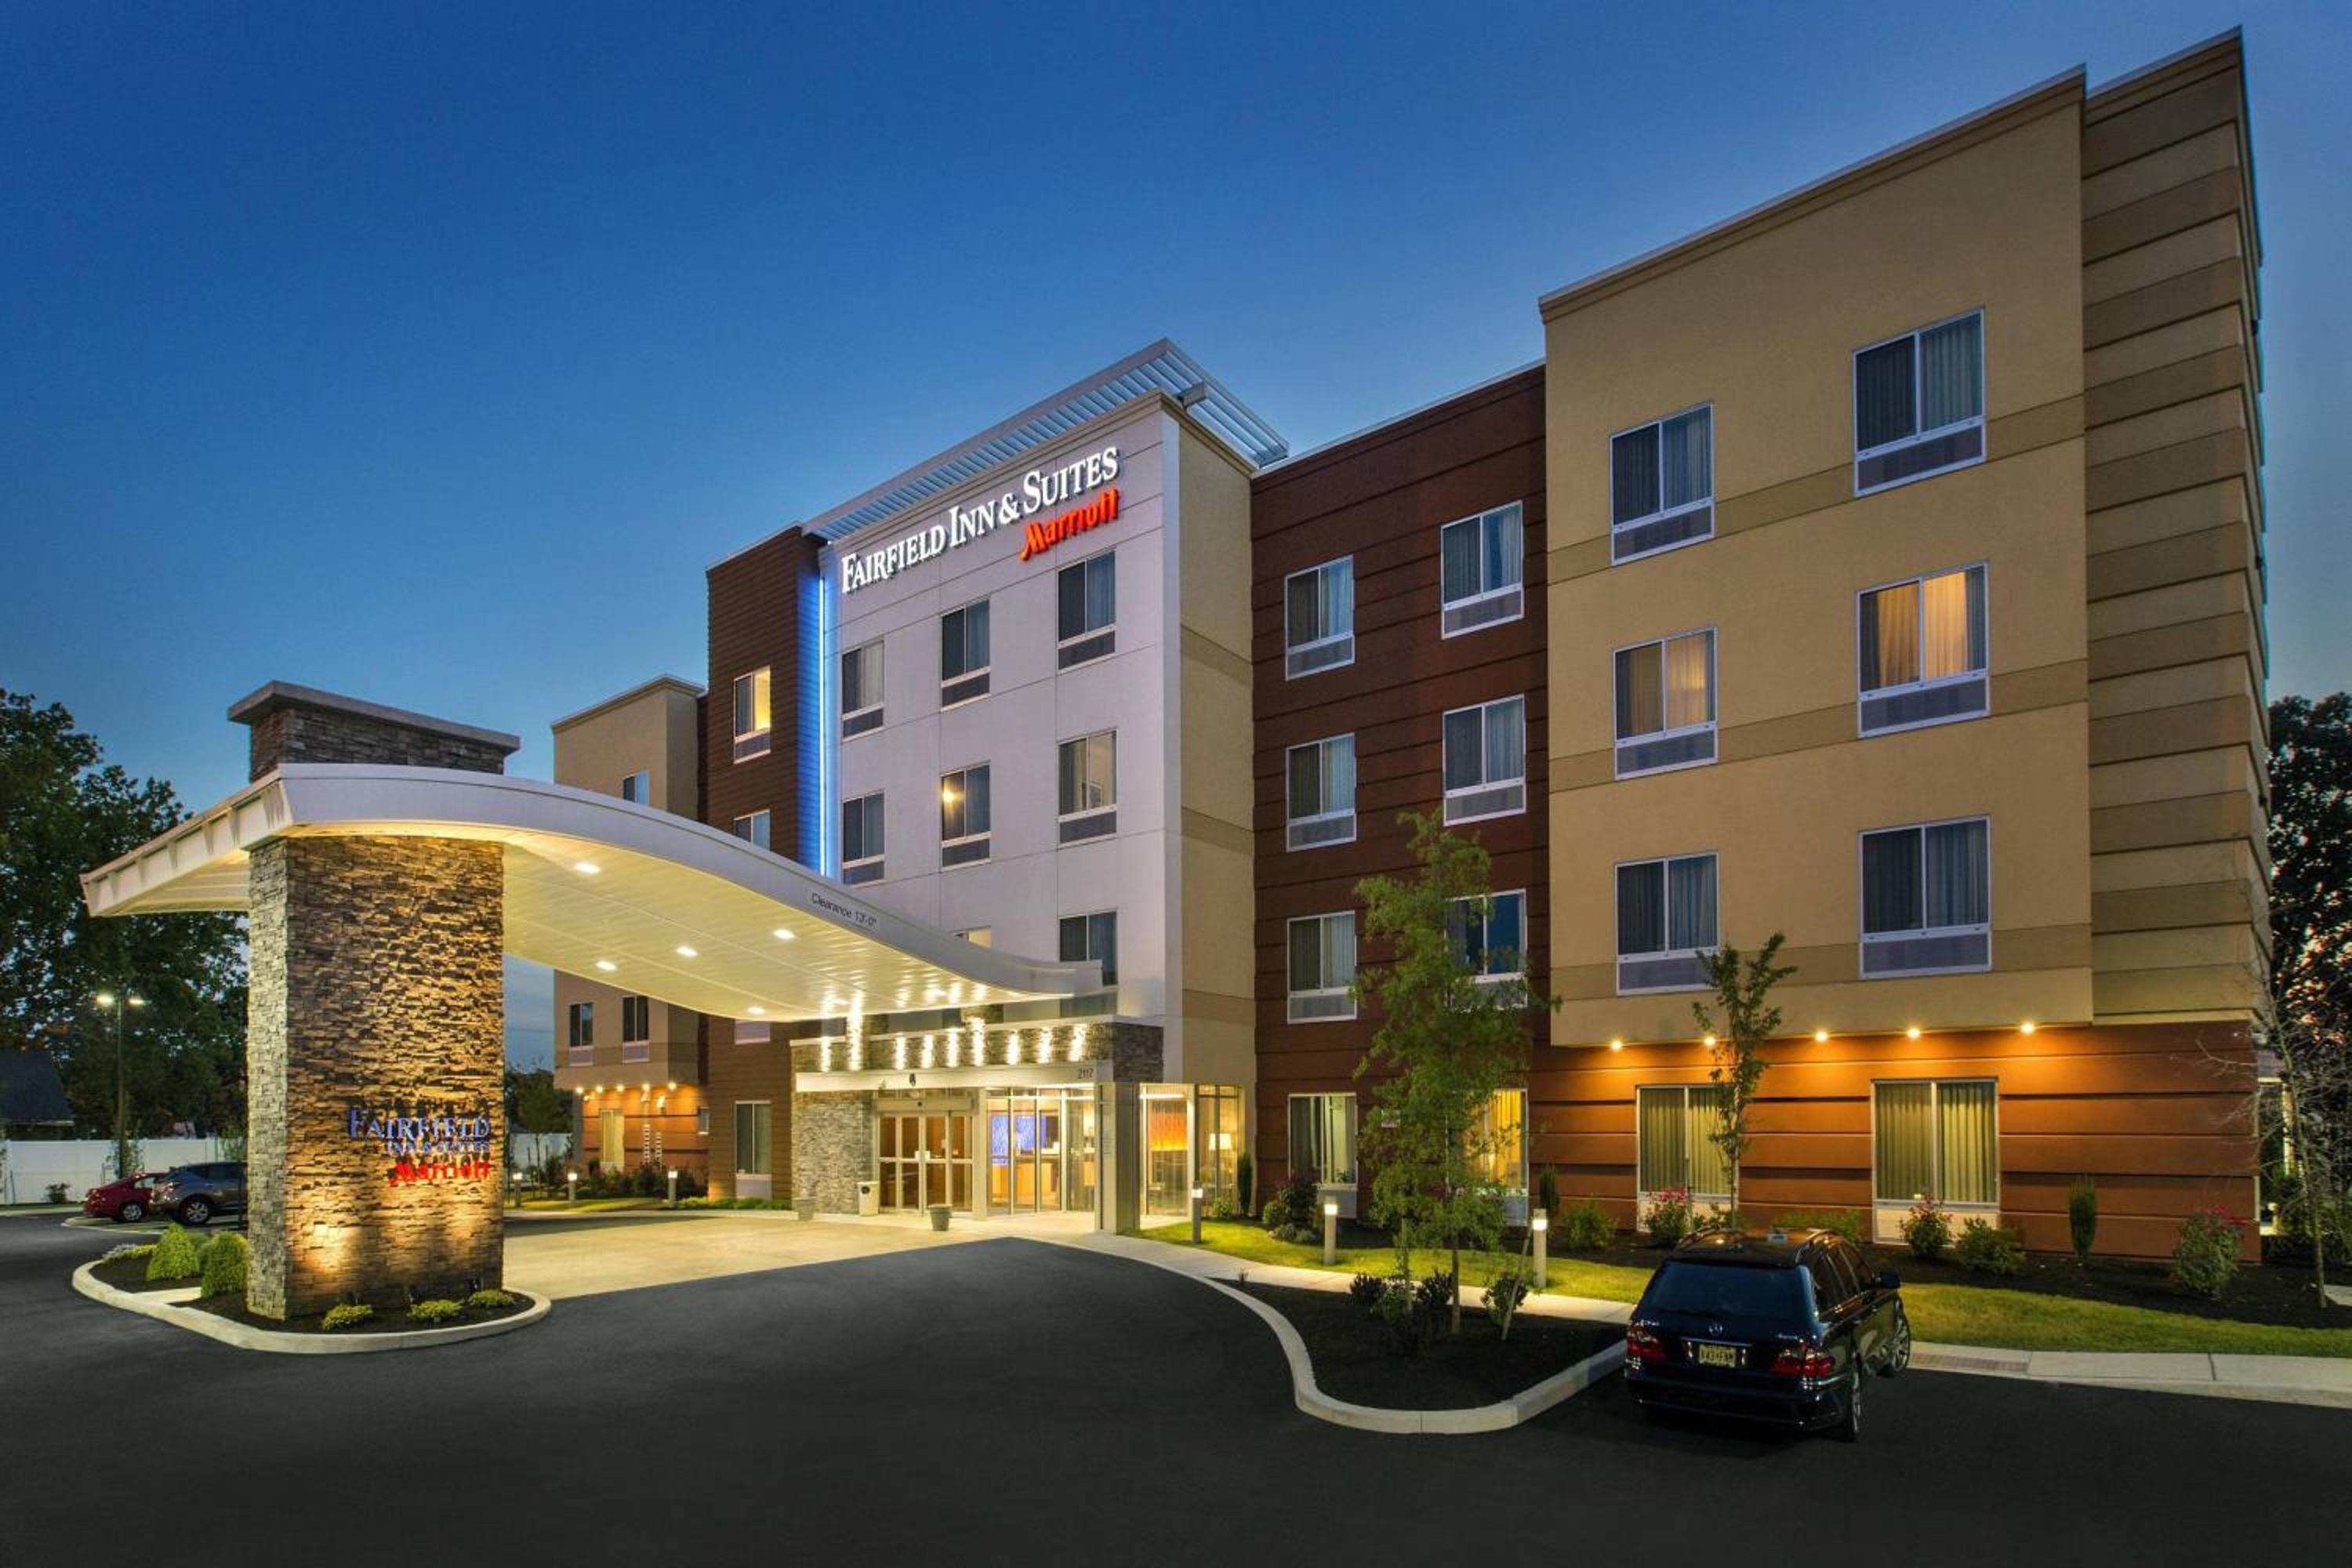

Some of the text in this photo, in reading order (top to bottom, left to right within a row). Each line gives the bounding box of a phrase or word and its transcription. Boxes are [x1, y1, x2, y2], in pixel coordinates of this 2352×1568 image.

[841, 447, 1119, 594] FAIRFIELD INN & SUITES
[1022, 486, 1120, 561] Marriott
[811, 892, 852, 916] Clearance
[349, 1106, 490, 1139] FAIRFIELD
[389, 1160, 490, 1187] Marriott
